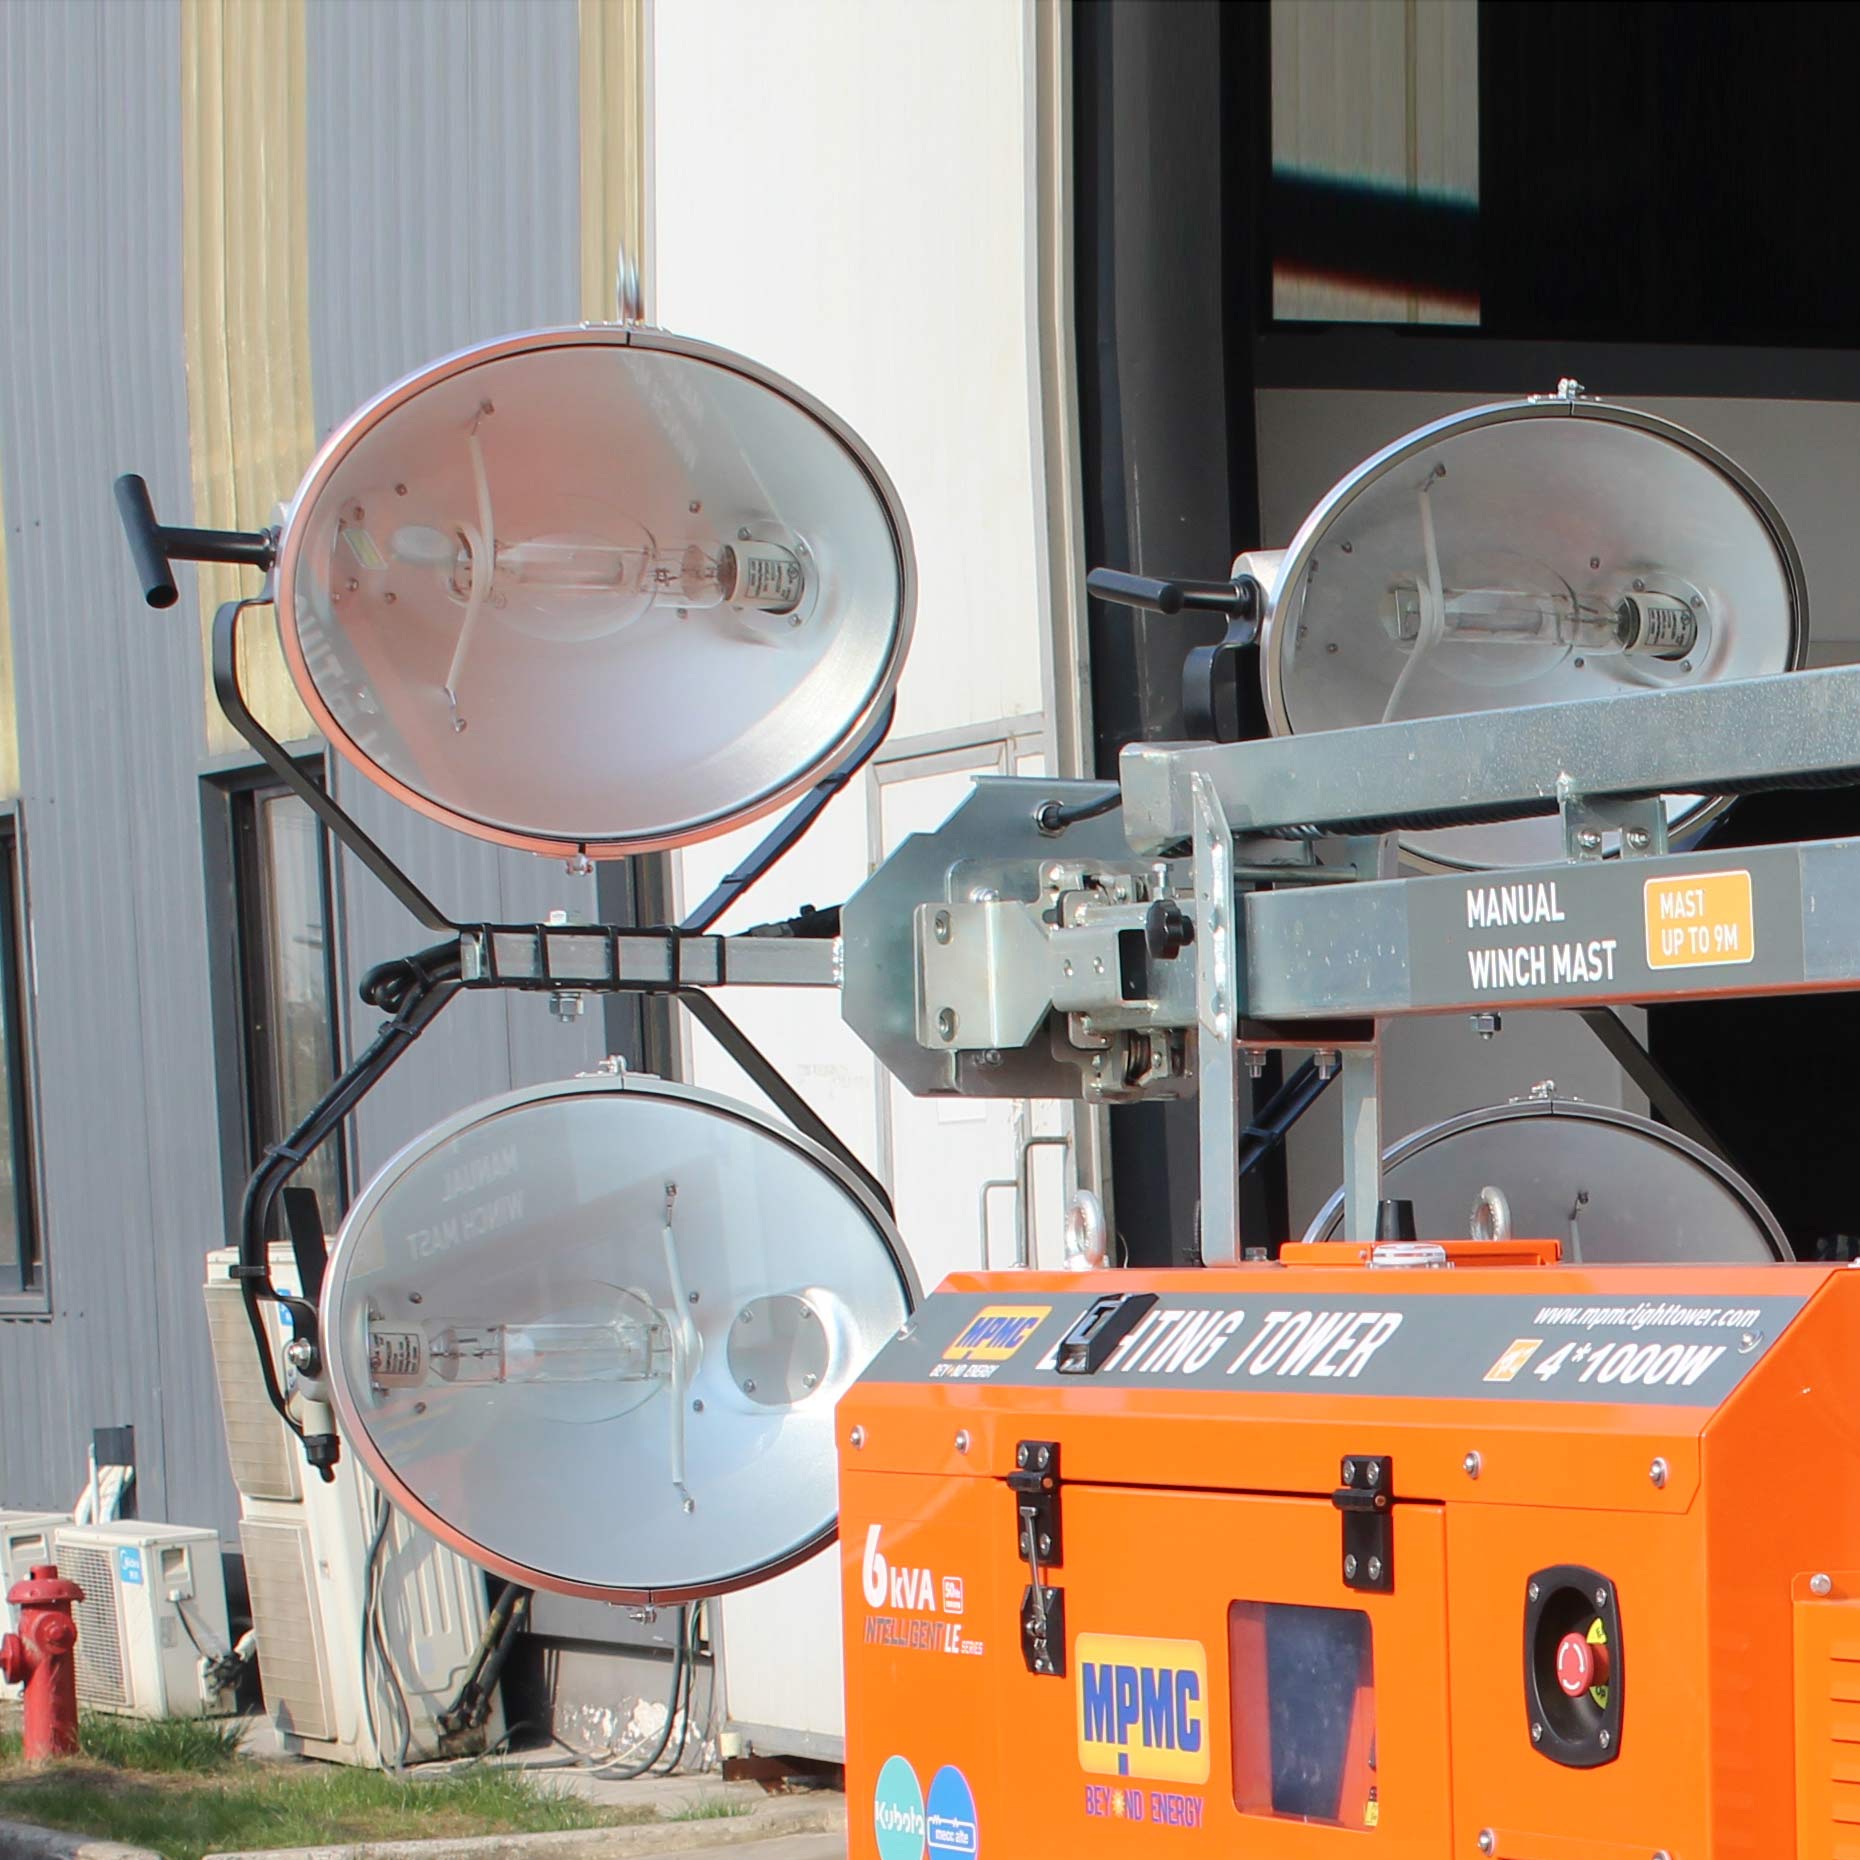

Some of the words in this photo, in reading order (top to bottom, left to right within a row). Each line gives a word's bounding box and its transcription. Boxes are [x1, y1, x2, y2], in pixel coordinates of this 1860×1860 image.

[1466, 881, 1565, 929] MANUAL
[1659, 888, 1706, 919] MAST
[1661, 927, 1684, 956] UP
[1688, 925, 1710, 954] TO
[1714, 923, 1738, 952] 9M
[1467, 945, 1546, 990] WINCH
[1552, 940, 1616, 984] MAST
[1533, 1302, 1761, 1331] www.mpmclighttower.com
[956, 1317, 1040, 1358] MPMC
[1227, 1311, 1403, 1378] TOWER
[864, 1615, 945, 1652] INTELLIGENT
[943, 1623, 962, 1654] LE
[1081, 1661, 1202, 1775] MPMC
[874, 1799, 926, 1836] Kubota
[1150, 1791, 1205, 1829] ENERGY
